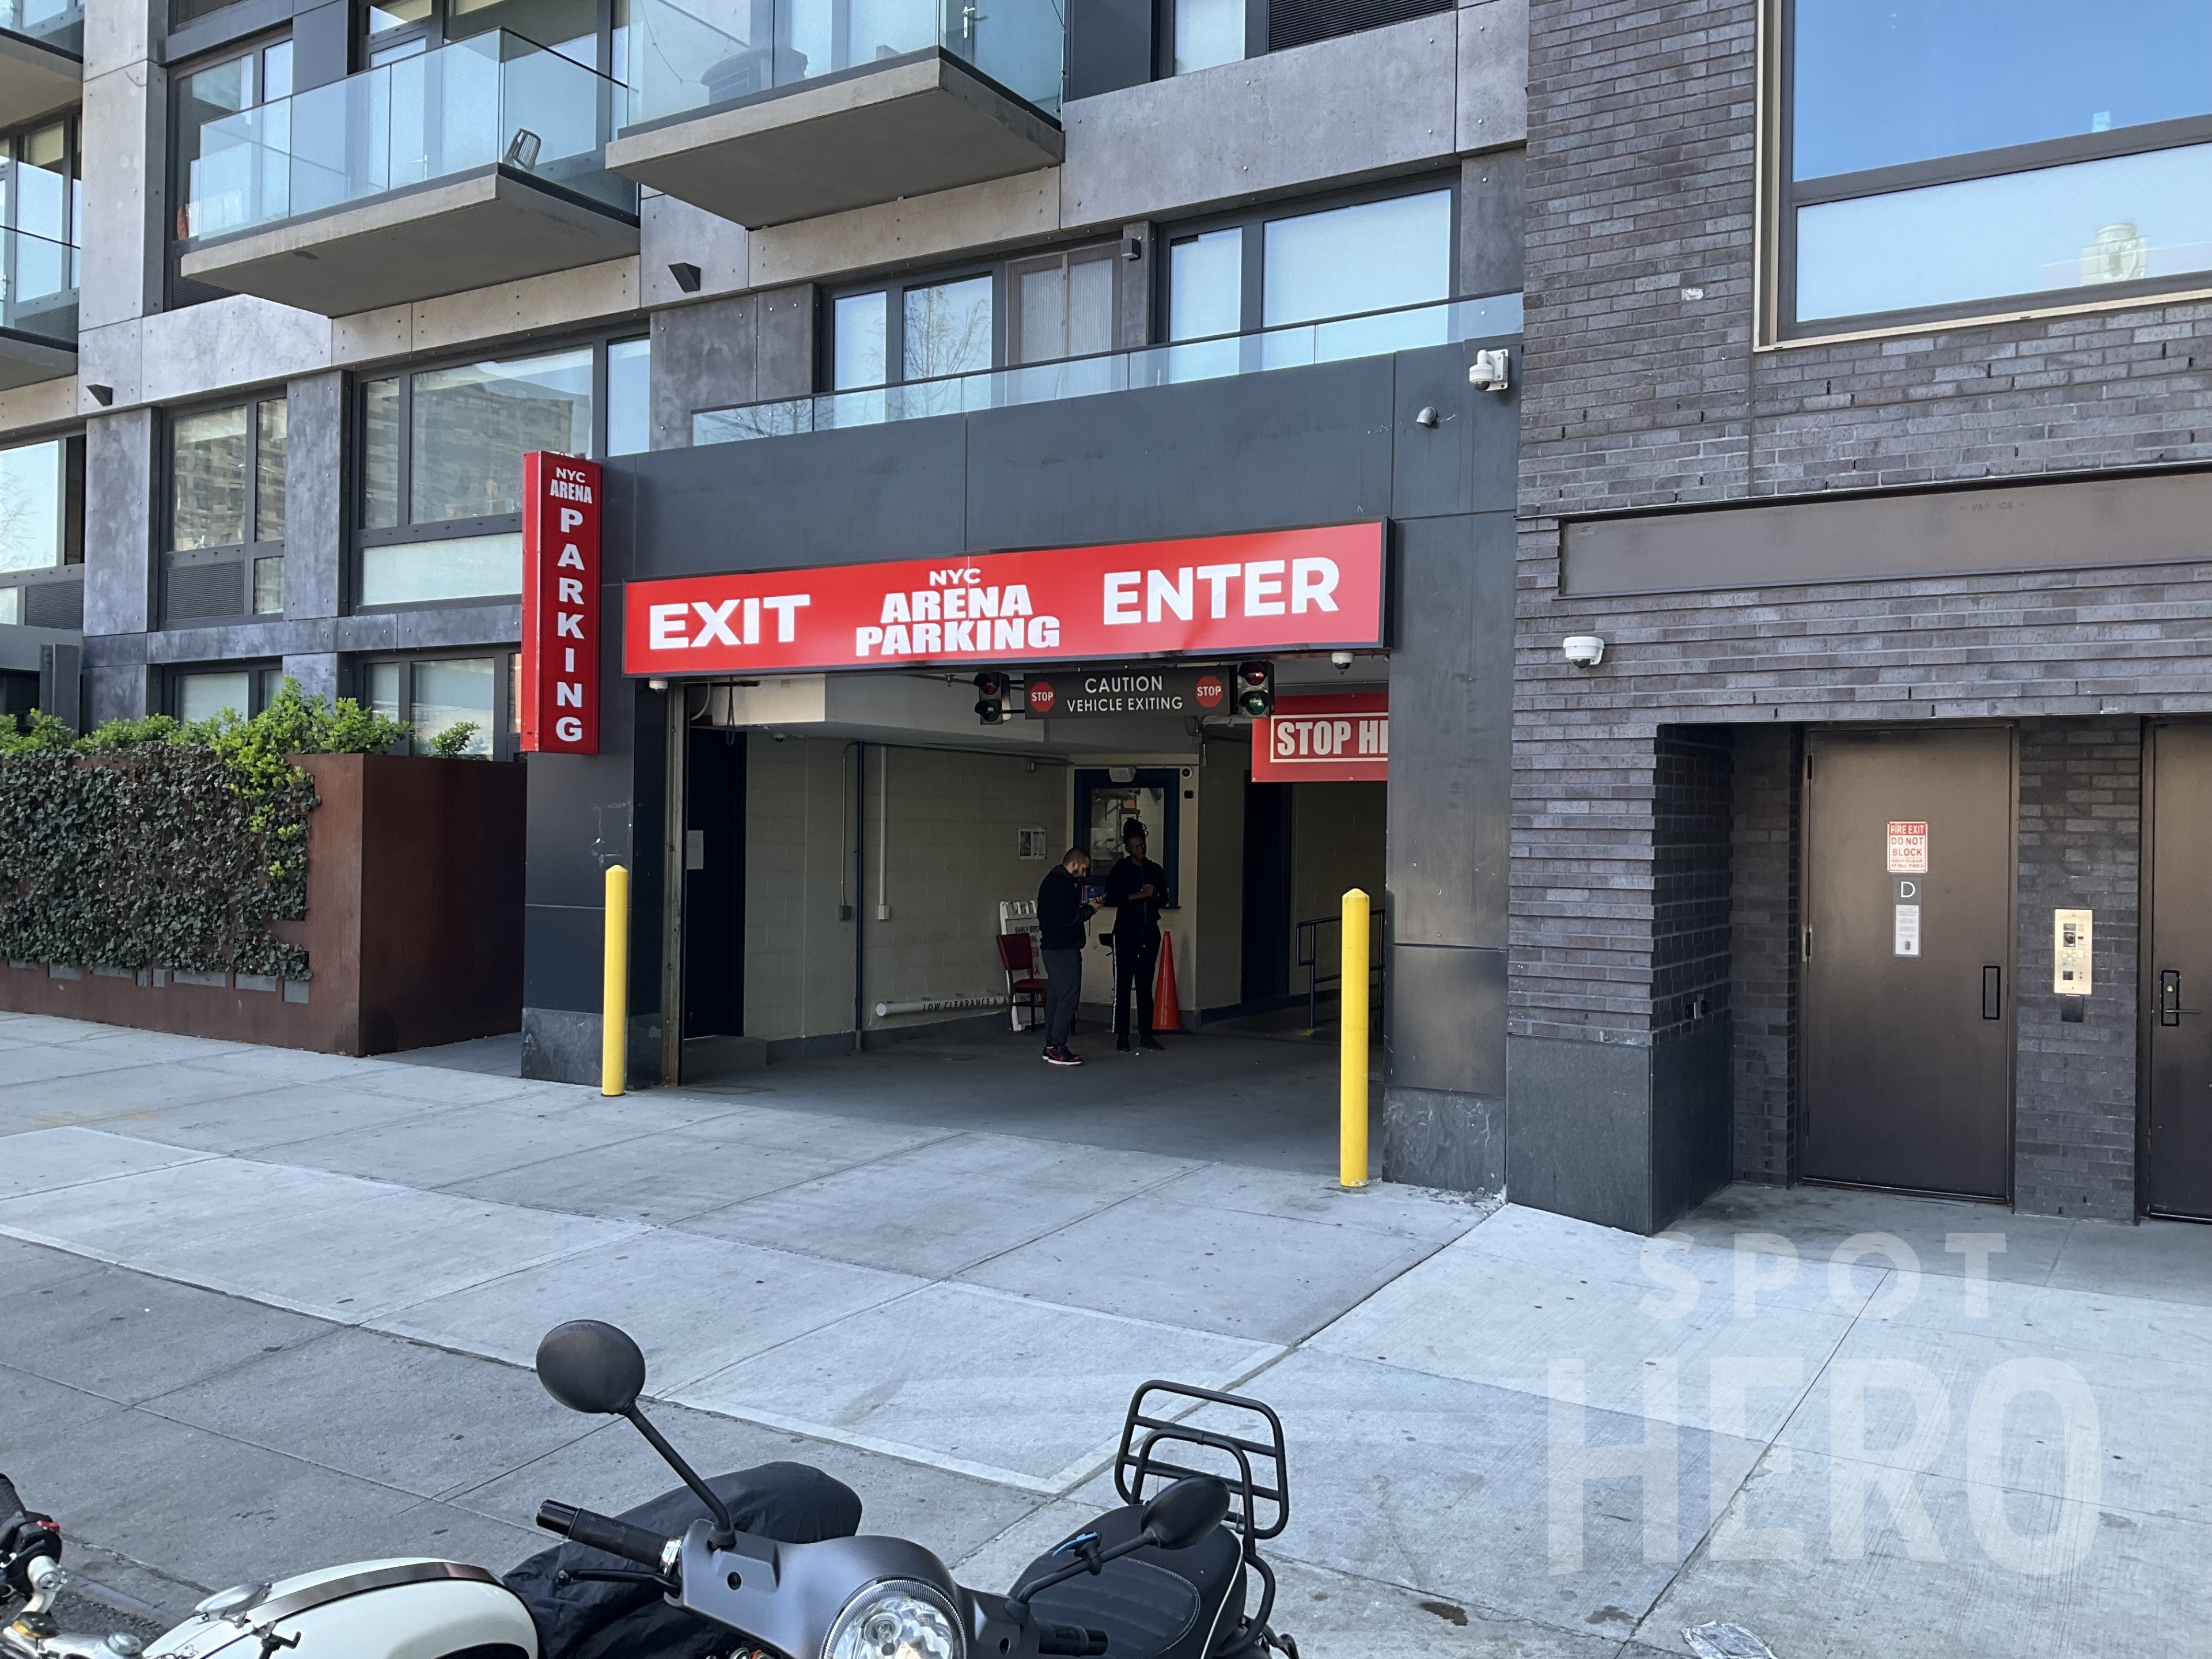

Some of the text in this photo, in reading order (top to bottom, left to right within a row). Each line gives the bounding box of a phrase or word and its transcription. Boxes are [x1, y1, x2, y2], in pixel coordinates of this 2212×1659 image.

[556, 467, 586, 483] NYC
[550, 479, 593, 505] ARENA
[929, 567, 981, 586] NYC
[1103, 556, 1339, 626] ENTER
[880, 584, 1033, 624] ARENA
[556, 507, 585, 742] PARKING
[649, 593, 810, 650] EXIT
[855, 615, 1060, 657] PARKING
[1085, 675, 1163, 694] CAUTION
[1196, 685, 1222, 697] STOP
[1031, 691, 1054, 702] STOP
[1067, 696, 1183, 713] VEHICLE EXITING
[1277, 720, 1351, 756] STOP
[1891, 825, 1925, 835] FIRE EXIT
[1891, 837, 1923, 845] DO NOT
[1892, 848, 1922, 857] BLOCK
[1900, 881, 1916, 898] D
[944, 998, 991, 1009] CLEARANCE
